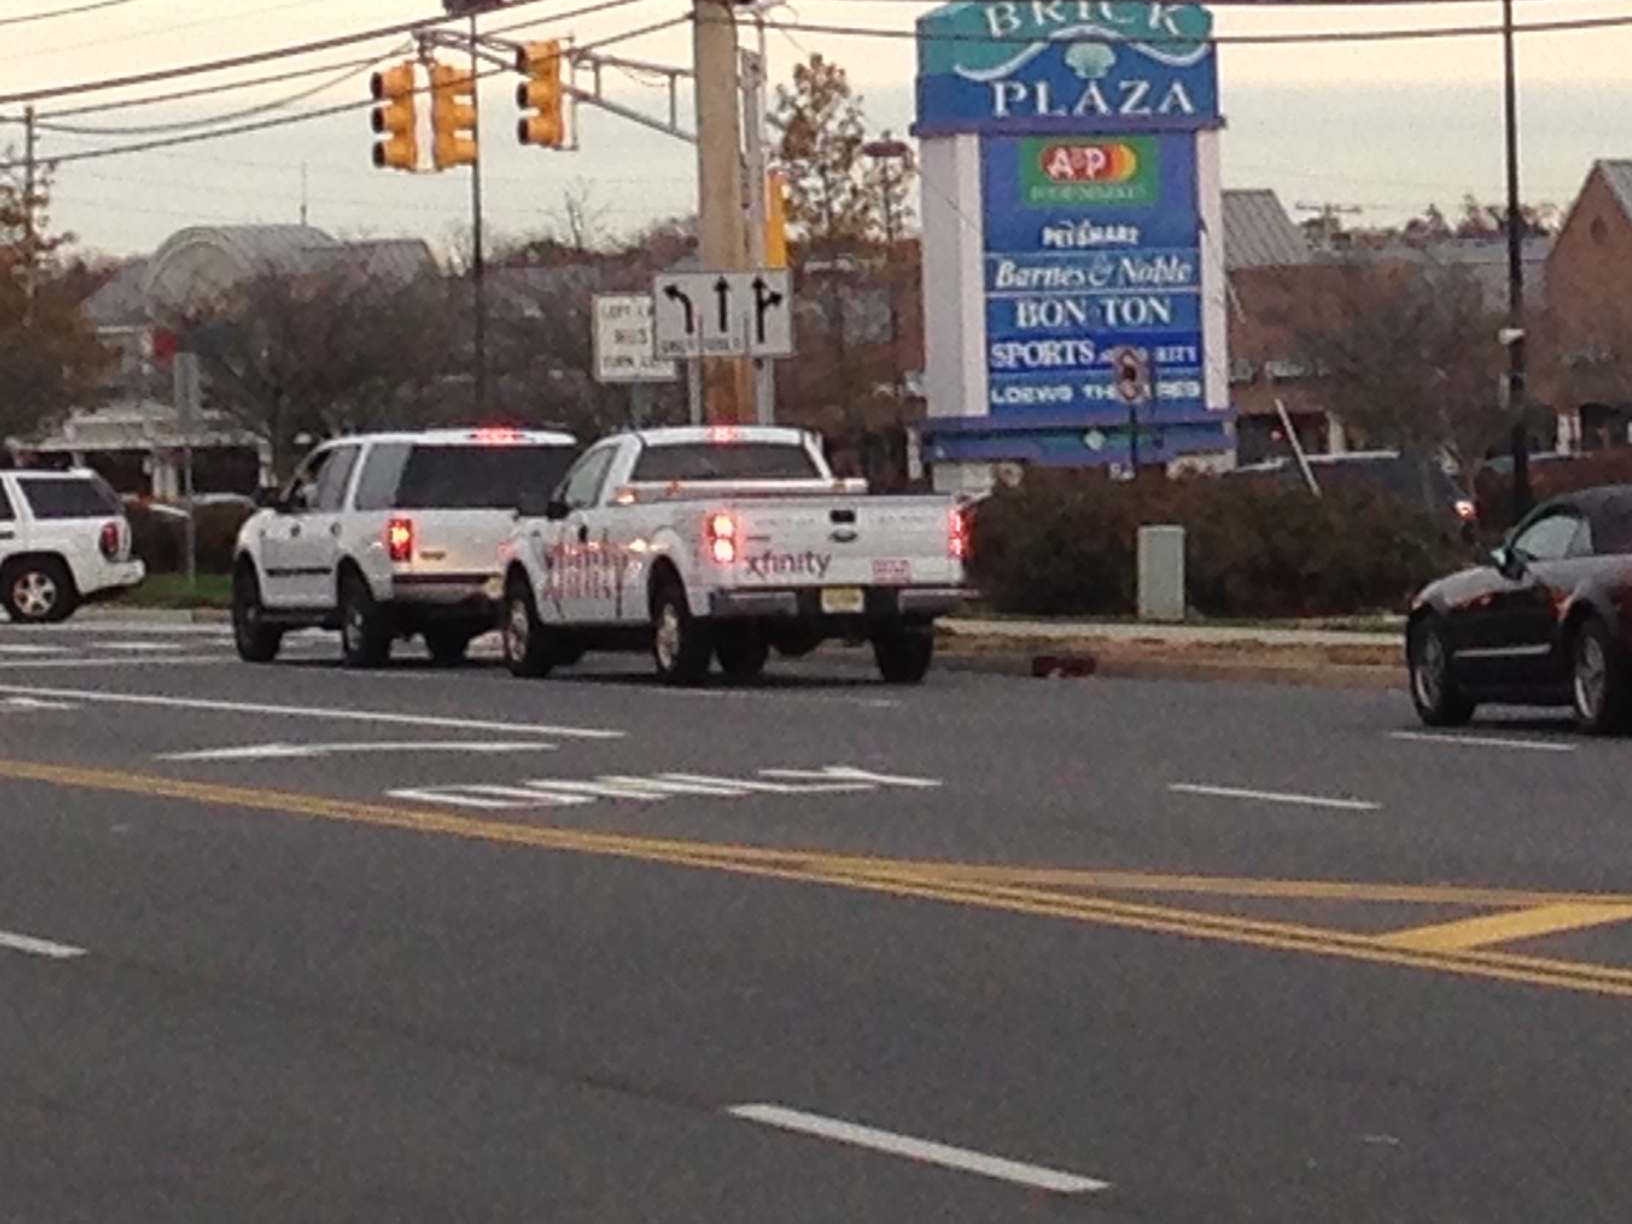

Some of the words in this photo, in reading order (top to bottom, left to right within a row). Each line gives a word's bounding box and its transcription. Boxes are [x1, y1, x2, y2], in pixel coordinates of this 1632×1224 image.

[991, 79, 1194, 117] PLAZA
[995, 260, 1085, 289] Barnes
[1116, 256, 1193, 285] Noble
[1016, 299, 1088, 327] BON
[1100, 297, 1173, 325] TON
[991, 339, 1096, 368] SPORTS
[746, 550, 832, 579] xfinity
